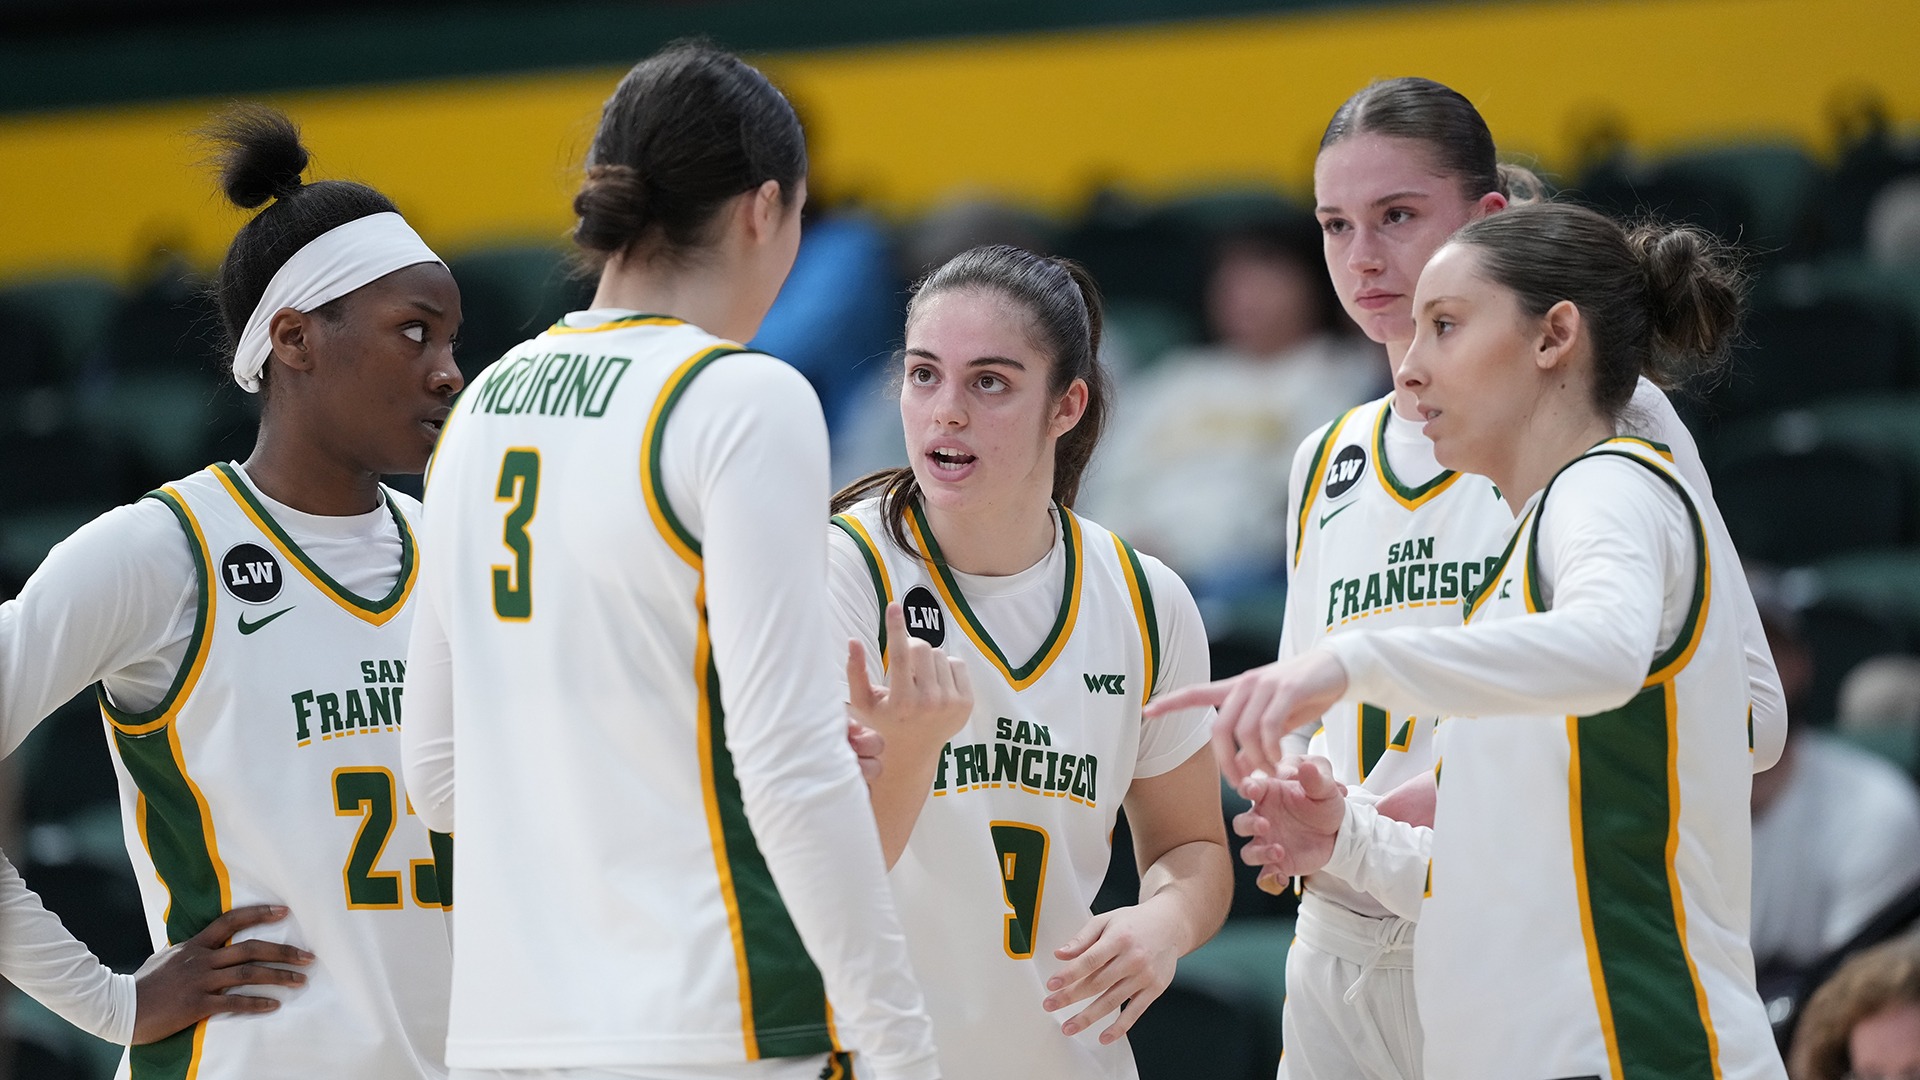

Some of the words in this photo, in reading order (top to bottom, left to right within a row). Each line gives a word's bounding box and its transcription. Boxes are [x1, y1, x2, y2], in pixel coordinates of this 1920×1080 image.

[1327, 458, 1363, 487] LW
[491, 446, 541, 622] 3
[1387, 536, 1435, 565] SAN
[227, 561, 274, 587] LW
[907, 605, 940, 632] LW
[1083, 673, 1126, 695] WCC
[996, 716, 1052, 747] SAN
[933, 741, 1098, 803] FRANCISCO
[989, 820, 1051, 960] 9
